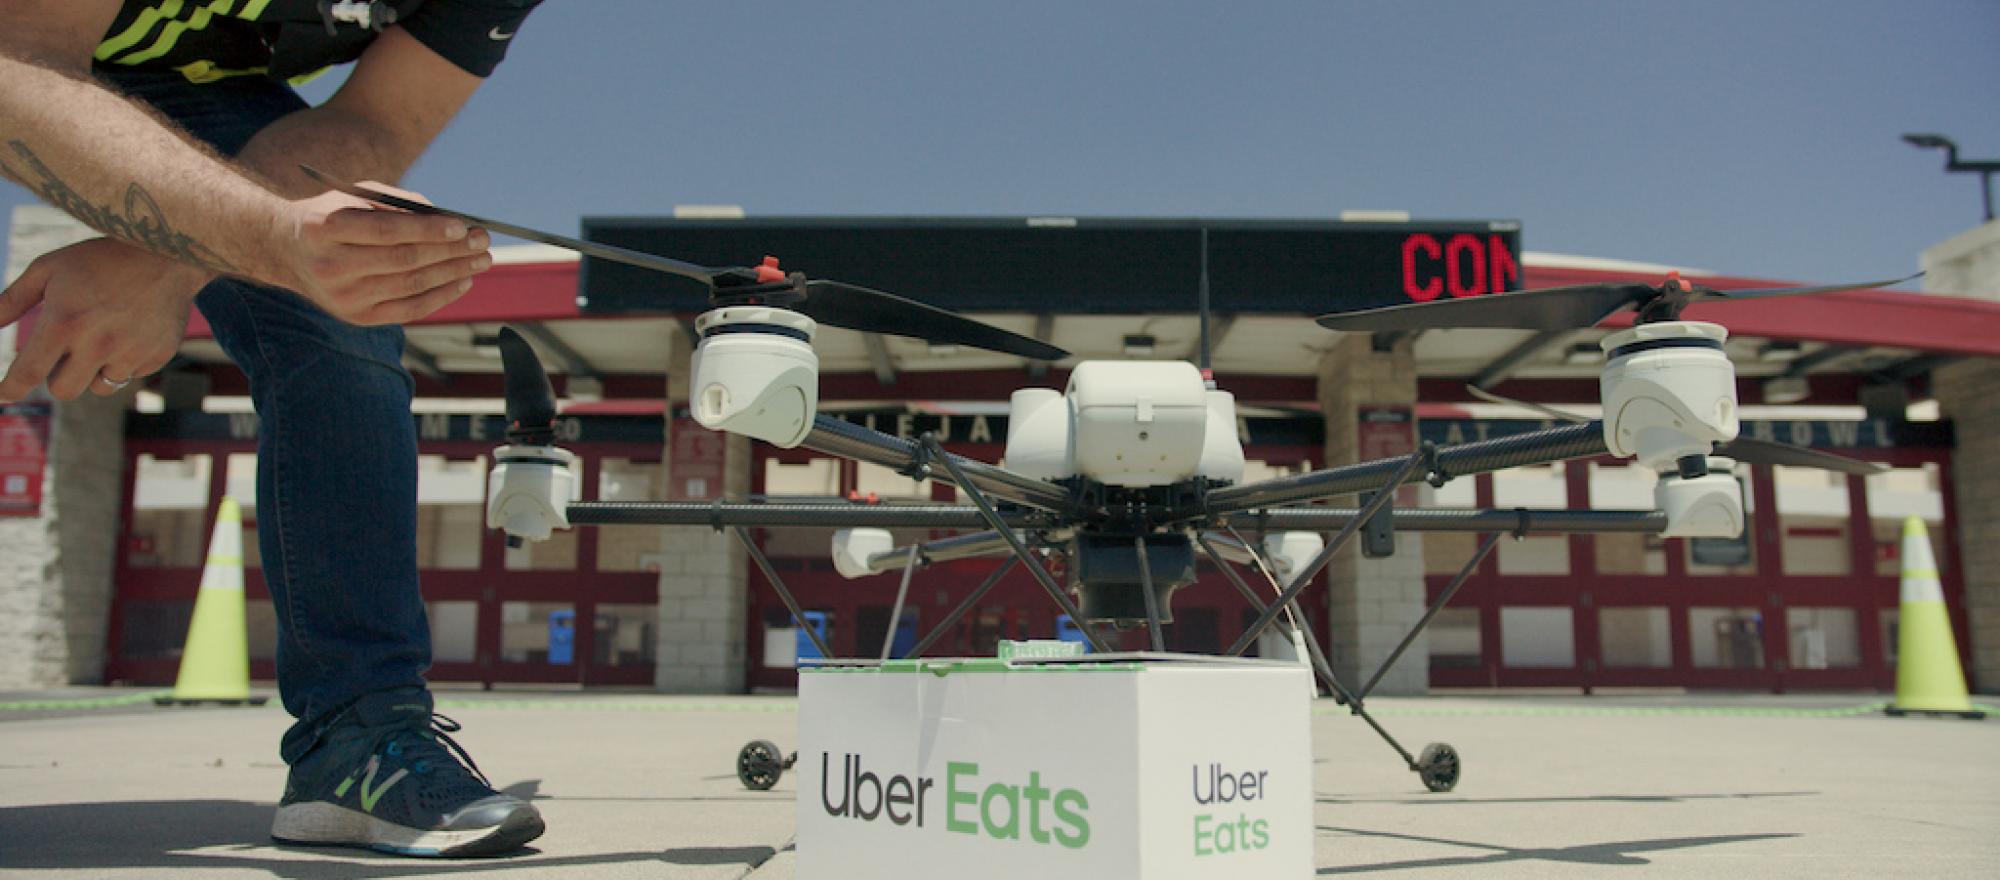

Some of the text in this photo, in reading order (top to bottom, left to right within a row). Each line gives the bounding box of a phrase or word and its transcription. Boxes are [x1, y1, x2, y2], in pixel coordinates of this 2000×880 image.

[821, 751, 1091, 849] Uber Eats
[1192, 763, 1269, 806] Uber
[1193, 812, 1270, 856] Eats
